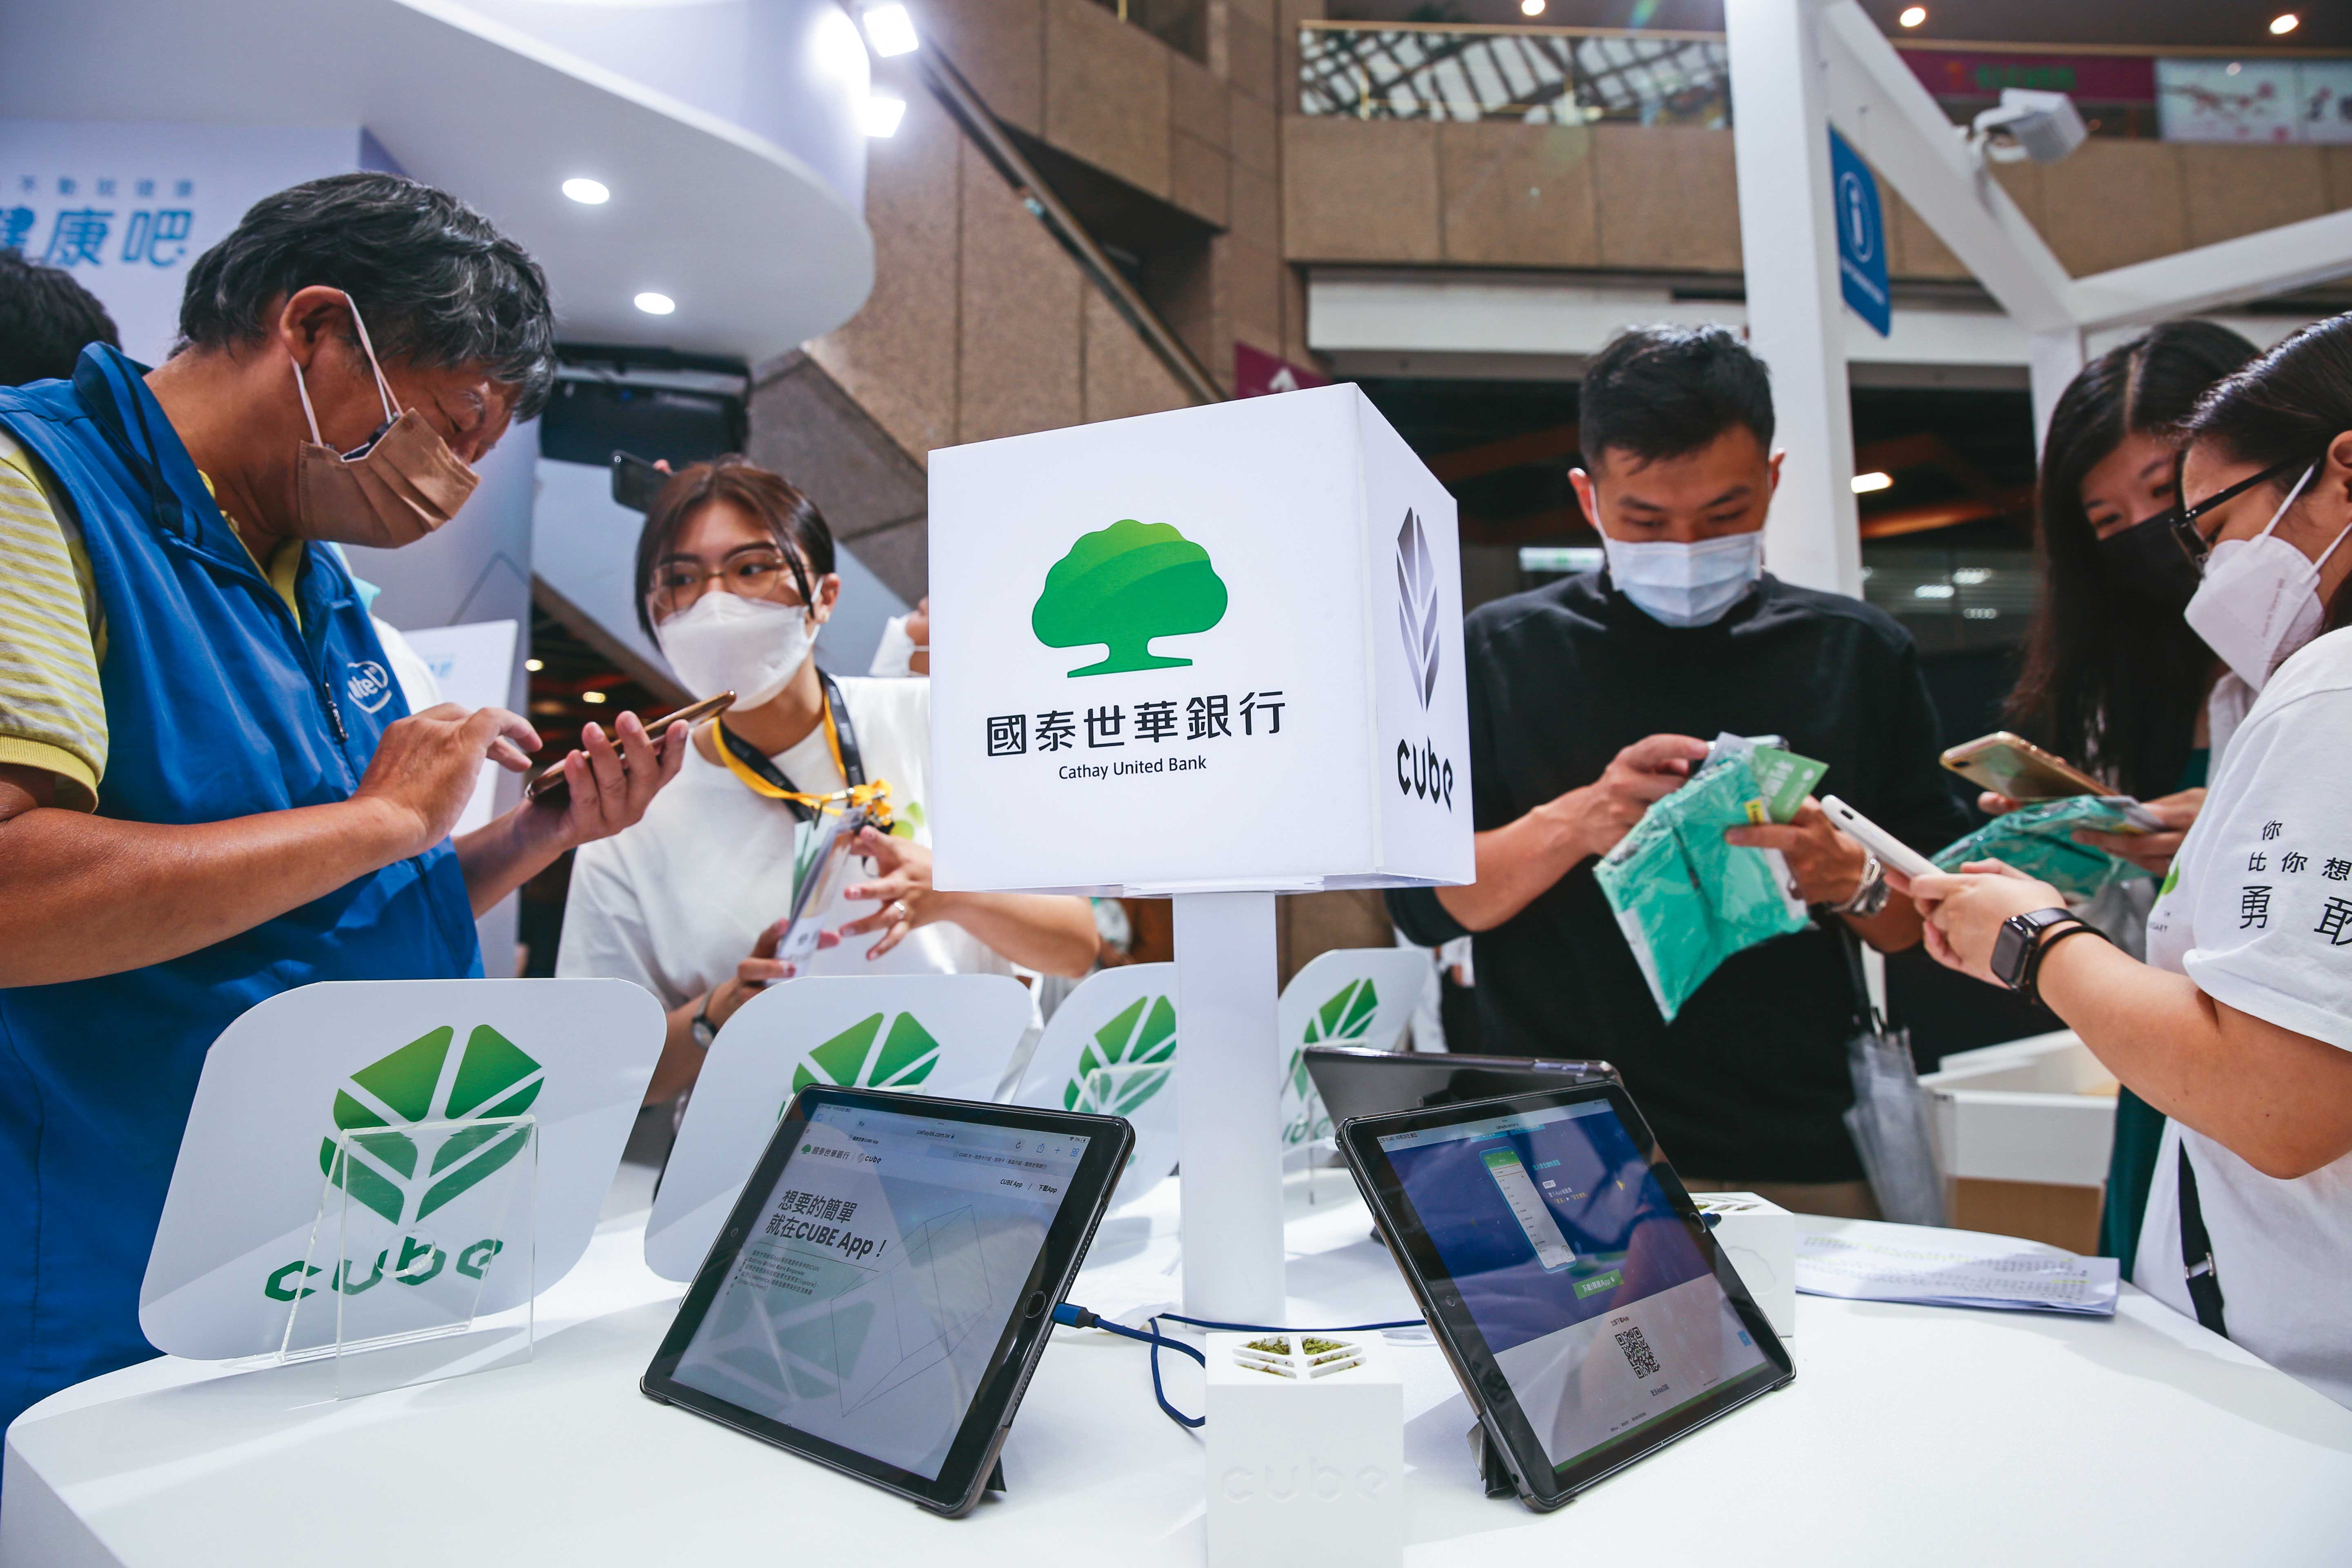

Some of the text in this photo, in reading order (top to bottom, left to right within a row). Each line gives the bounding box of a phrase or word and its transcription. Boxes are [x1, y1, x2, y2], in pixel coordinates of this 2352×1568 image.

[987, 691, 1285, 757] 國泰世華銀行
[1059, 755, 1207, 780] Cathay United Bank
[1397, 734, 1453, 813] cube
[2262, 820, 2283, 840] 你
[917, 1129, 951, 1138] cathaybk.com.tw
[811, 1147, 850, 1160] 國泰世華銀行
[864, 1155, 882, 1164] cube
[1038, 1184, 1058, 1194] 下載App
[778, 1189, 858, 1223] 想要的簡單
[766, 1213, 840, 1246] 就在CUBE
[264, 1236, 503, 1301] cube
[786, 1267, 806, 1276] Empower
[1221, 1454, 1389, 1506] cube
